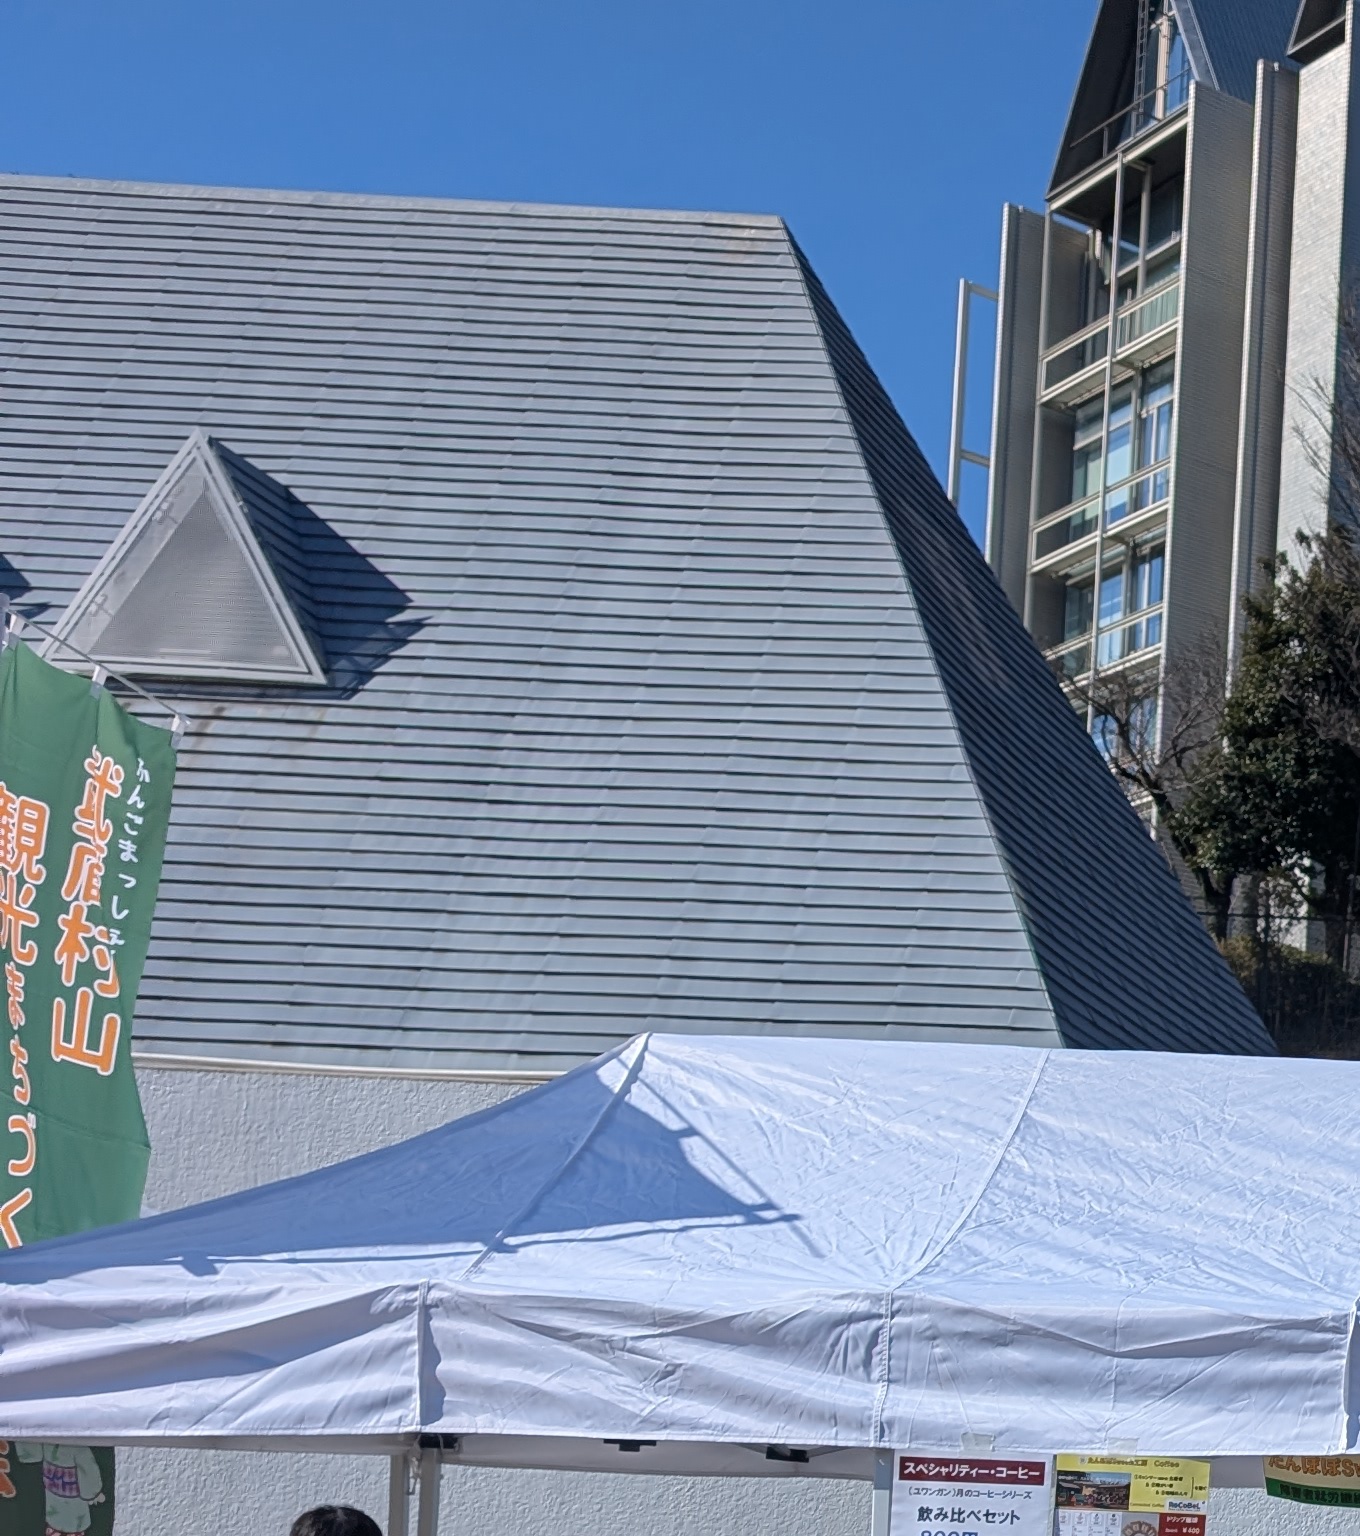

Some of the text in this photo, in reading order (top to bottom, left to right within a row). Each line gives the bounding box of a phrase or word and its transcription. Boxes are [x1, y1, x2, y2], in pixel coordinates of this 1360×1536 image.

[0, 781, 50, 1249] 観光まちづく
[904, 1461, 1040, 1480] スペシャリティー・コーヒー
[917, 1506, 1020, 1525] 飲み比べセット
